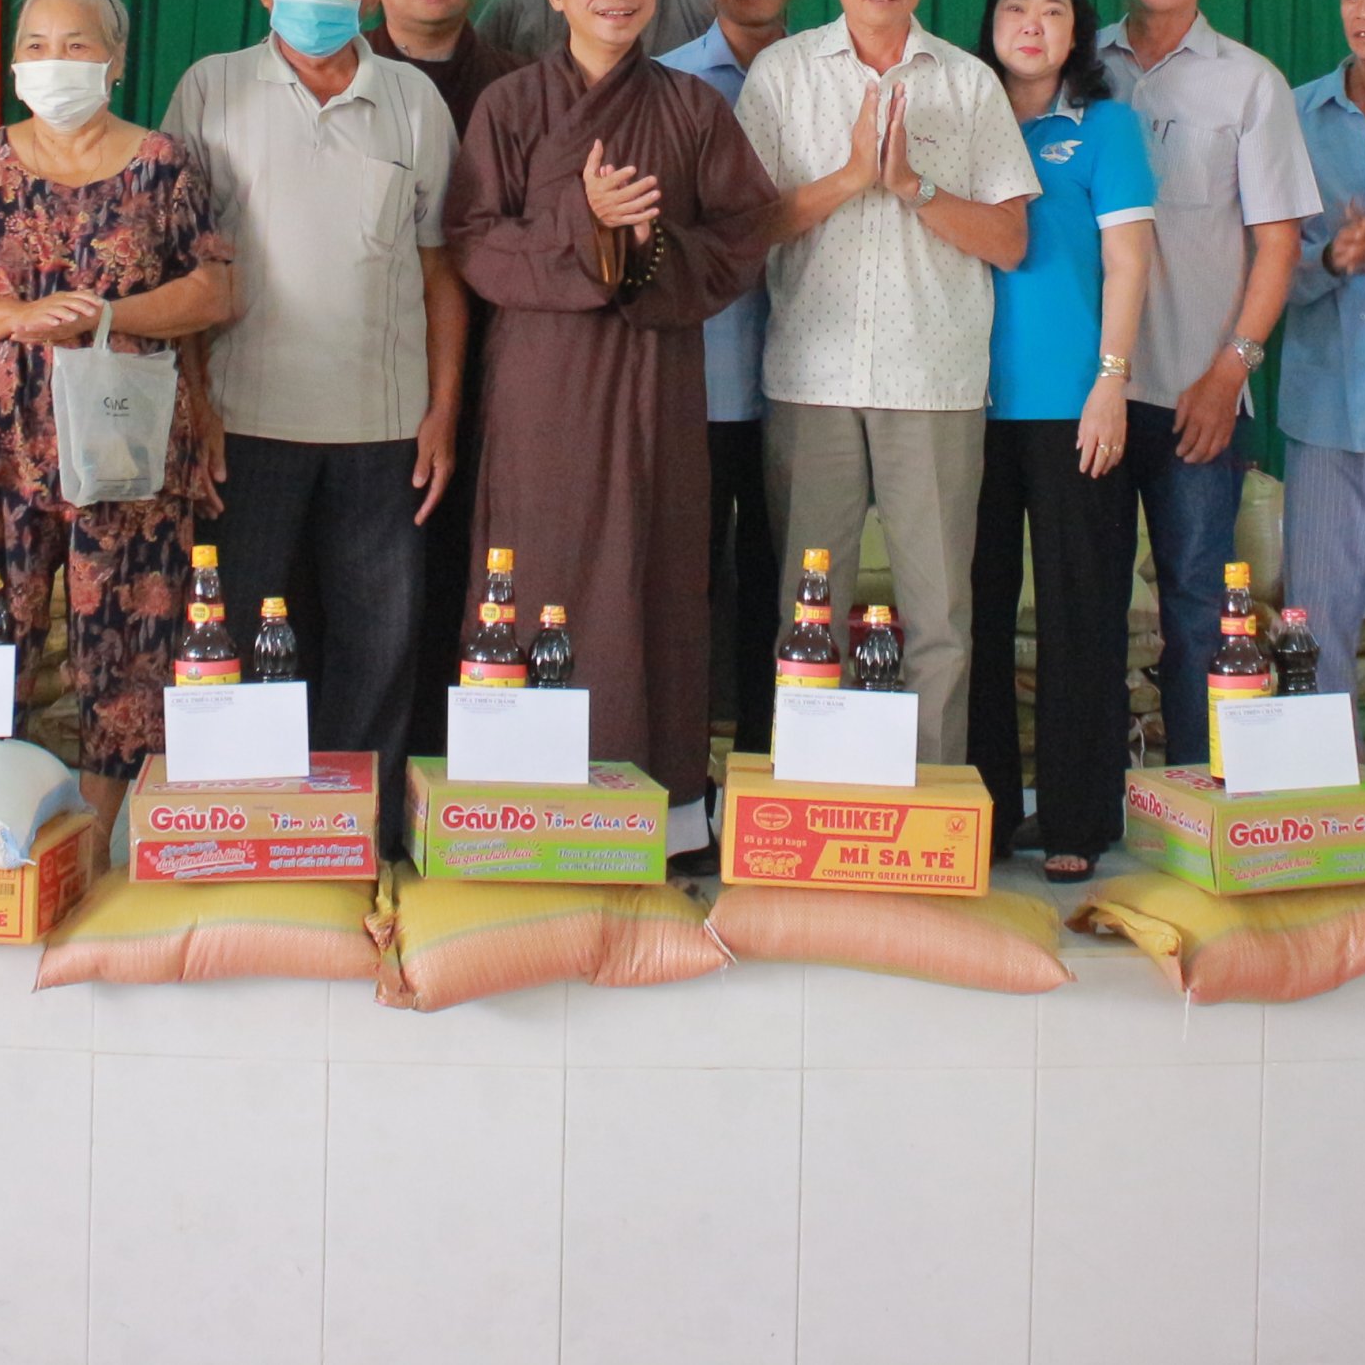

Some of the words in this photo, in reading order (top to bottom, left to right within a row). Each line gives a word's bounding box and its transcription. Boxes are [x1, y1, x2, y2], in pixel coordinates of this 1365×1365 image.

[809, 806, 894, 832] MILIKET
[839, 843, 870, 865] MÌ
[878, 849, 912, 867] SA
[822, 869, 875, 880] COMMUNITY
[878, 871, 909, 882] GREEN
[910, 872, 966, 884] ENTERPRISE
